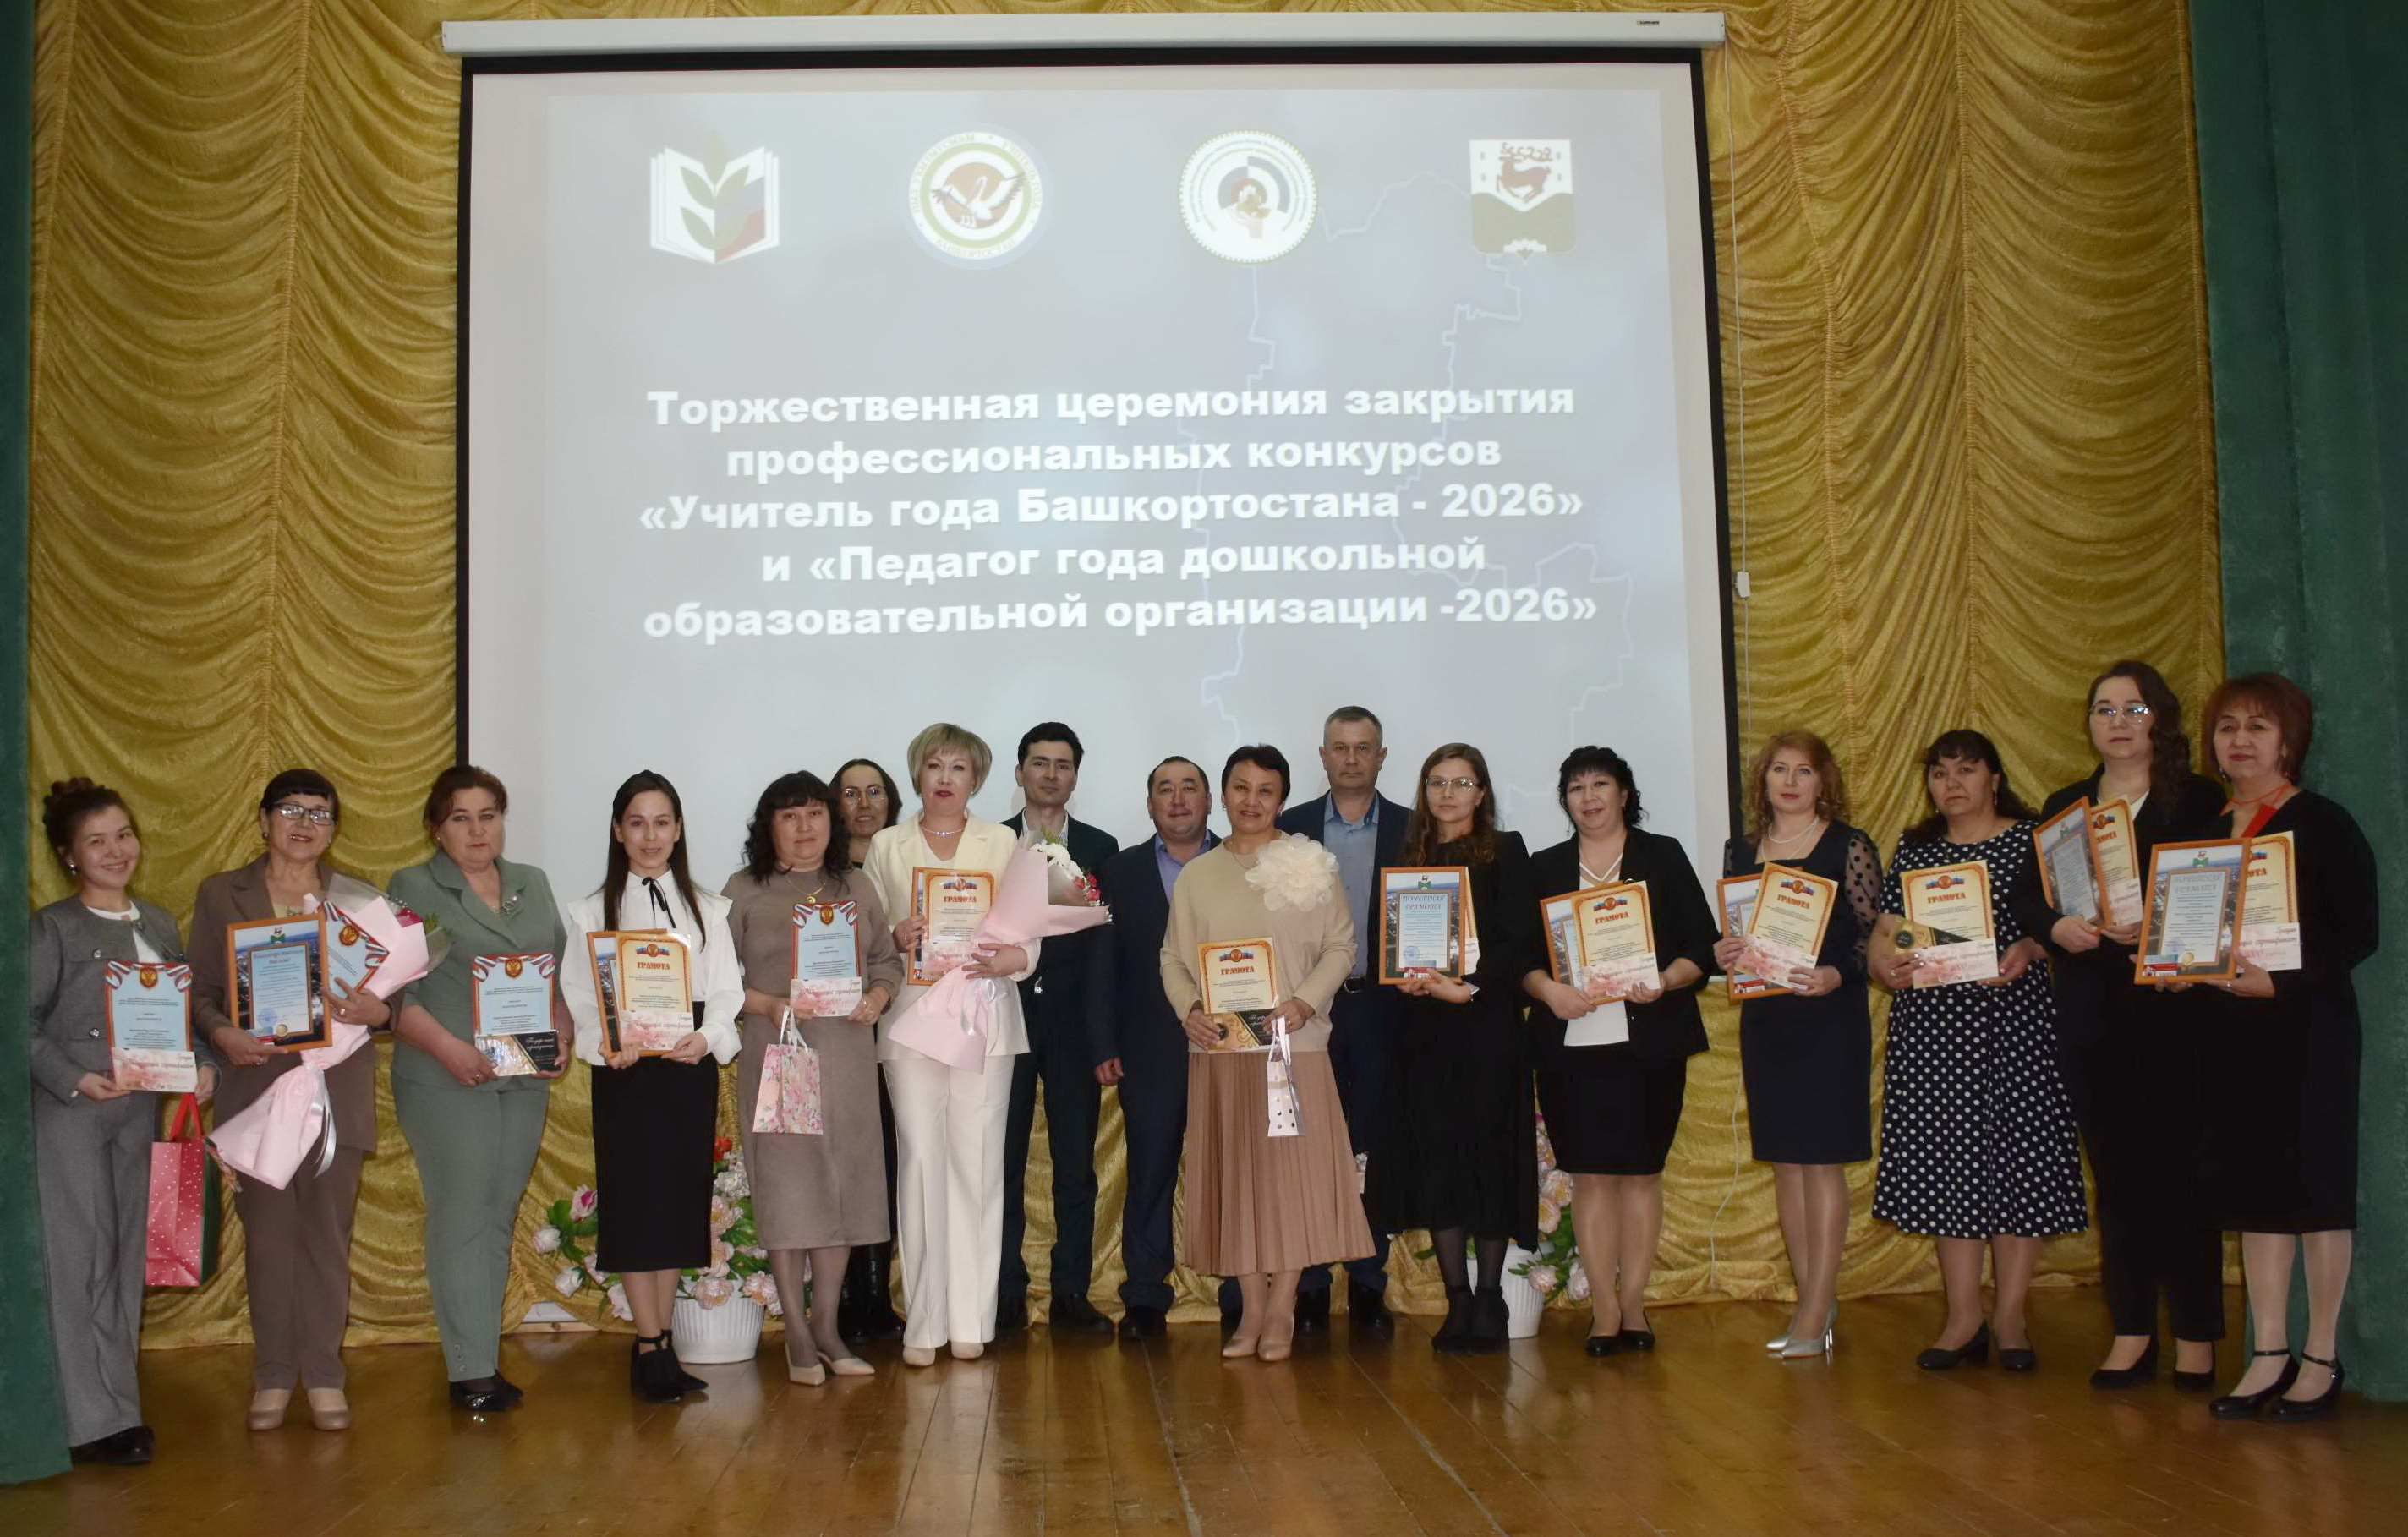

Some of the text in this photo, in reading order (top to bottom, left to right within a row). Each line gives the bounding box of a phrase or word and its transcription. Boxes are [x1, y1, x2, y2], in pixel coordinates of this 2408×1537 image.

[646, 385, 1575, 434] Торжественная церемония закрытия
[727, 439, 1502, 484] профессиональных конкурсов
[639, 482, 1584, 532] «Учитель года Башкортостана - 2026»
[762, 535, 1486, 586] и «Педагог года дошкольной
[643, 585, 1598, 647] образовательной организации -2026»
[1776, 893, 1810, 910] ГРАМОТА
[1927, 892, 1966, 904] ГРАМОТА
[1595, 911, 1629, 925] ГРАМОТА
[637, 961, 670, 970] ГРАМОТА
[1220, 965, 1255, 976] ГРАМОТА
